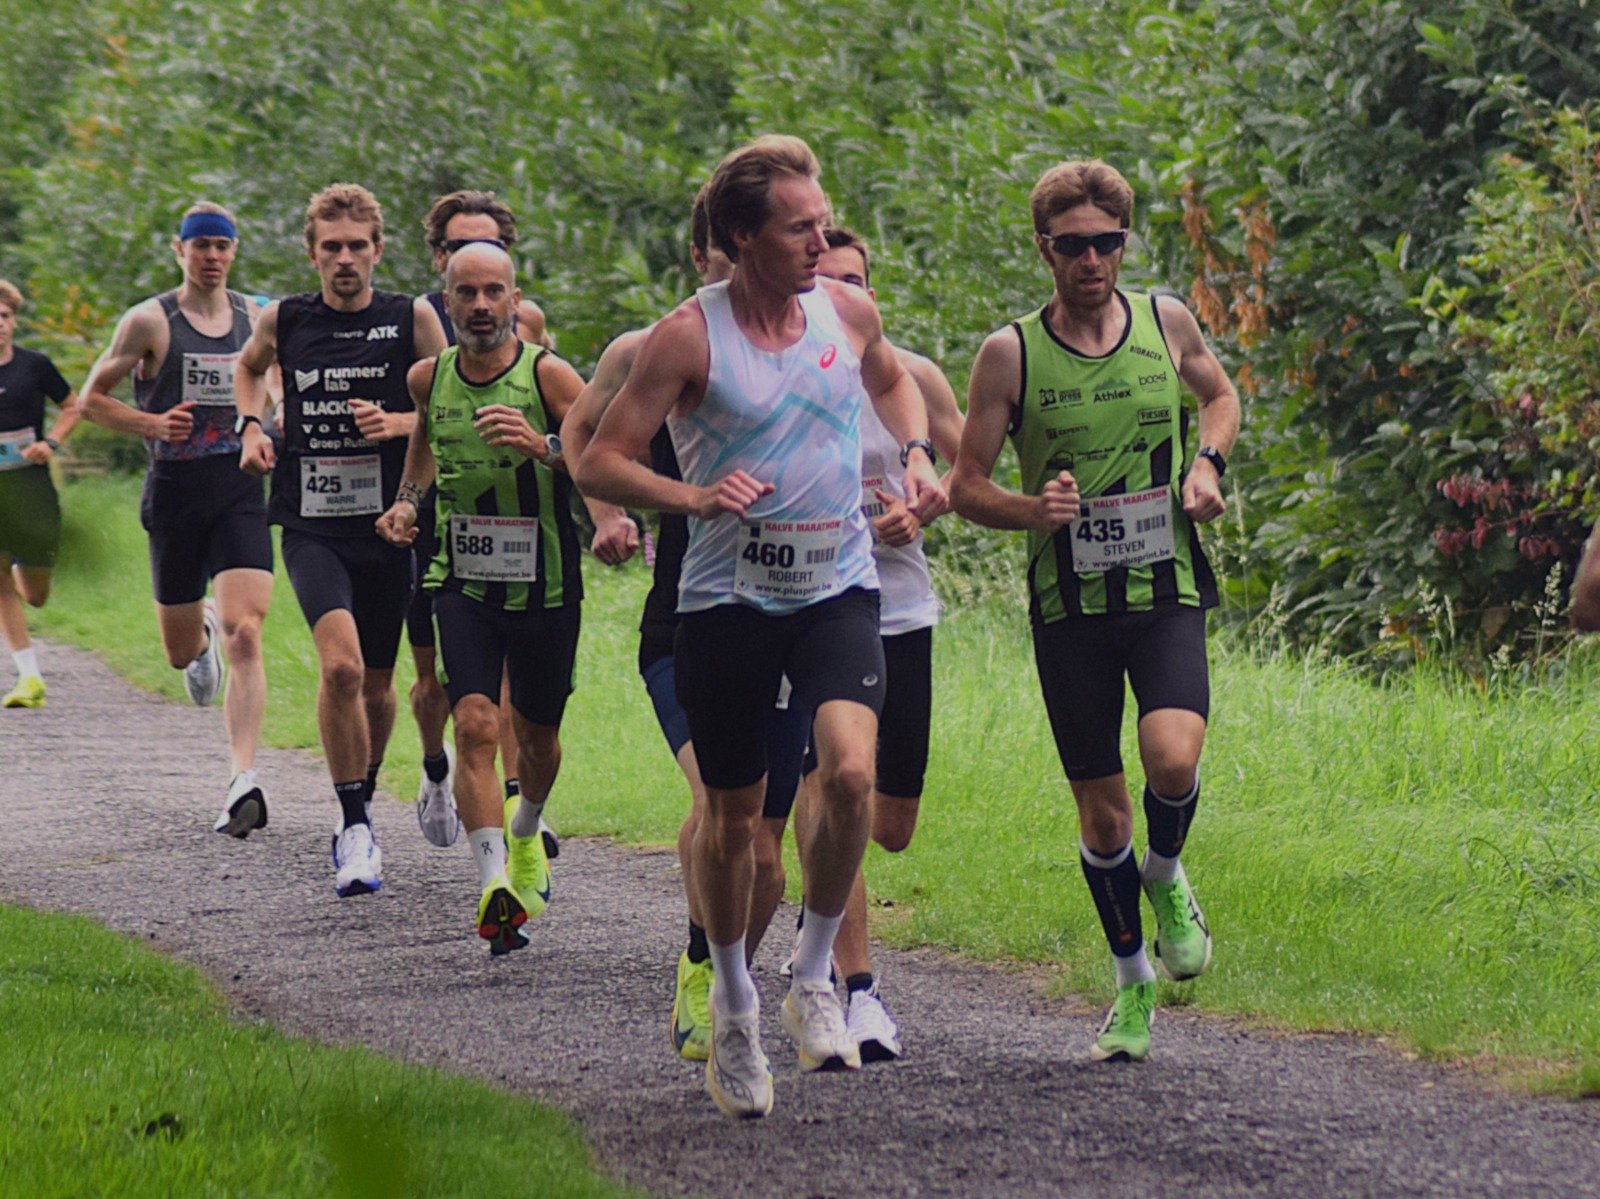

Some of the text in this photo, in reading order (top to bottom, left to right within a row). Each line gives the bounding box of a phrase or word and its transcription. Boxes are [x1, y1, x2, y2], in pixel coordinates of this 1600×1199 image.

[366, 325, 399, 341] ATK
[187, 369, 220, 386] 576
[324, 378, 351, 391] lab
[1093, 389, 1132, 404] Athlex
[309, 437, 342, 450] Groep
[306, 475, 342, 494] 425
[861, 477, 882, 488] THON
[325, 494, 357, 505] WARRE
[1092, 498, 1120, 508] HALVE
[1122, 489, 1168, 506] MARATHON
[470, 517, 492, 526] HALVE
[494, 518, 535, 527] MARATHON
[764, 520, 841, 532] HALVE MARATHON
[1076, 518, 1126, 543] 435
[456, 534, 494, 556] 588
[1103, 540, 1145, 557] STEVEN
[742, 541, 795, 569] 460
[768, 570, 814, 583] ROBERT
[755, 582, 832, 596] www.plusprint.be
